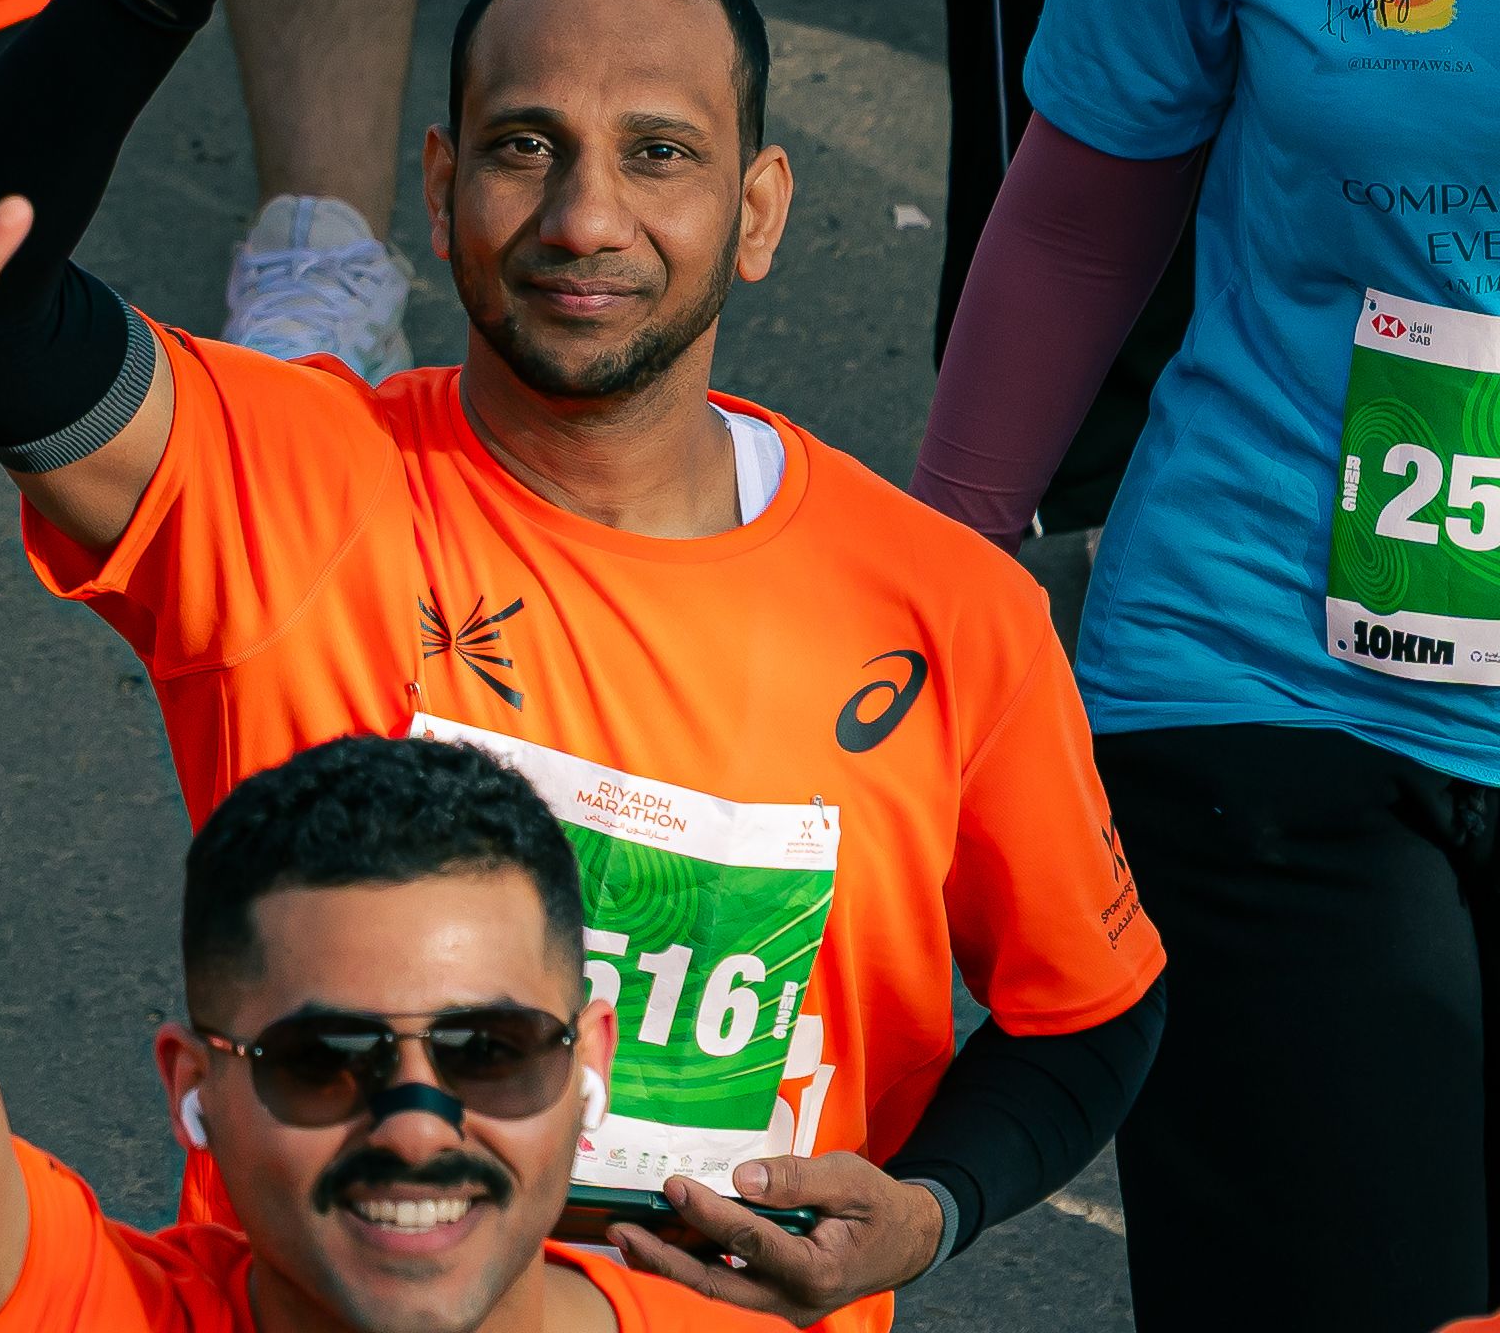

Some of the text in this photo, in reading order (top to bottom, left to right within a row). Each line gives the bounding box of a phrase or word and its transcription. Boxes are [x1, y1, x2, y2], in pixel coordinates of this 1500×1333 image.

[1349, 57, 1475, 74] @HAPPYPAWS.SA
[1408, 321, 1434, 336] الأول
[1408, 333, 1432, 347] SAB
[1353, 619, 1456, 666] 10KM
[598, 780, 673, 813] RIYADH
[576, 790, 688, 833] MARATHON
